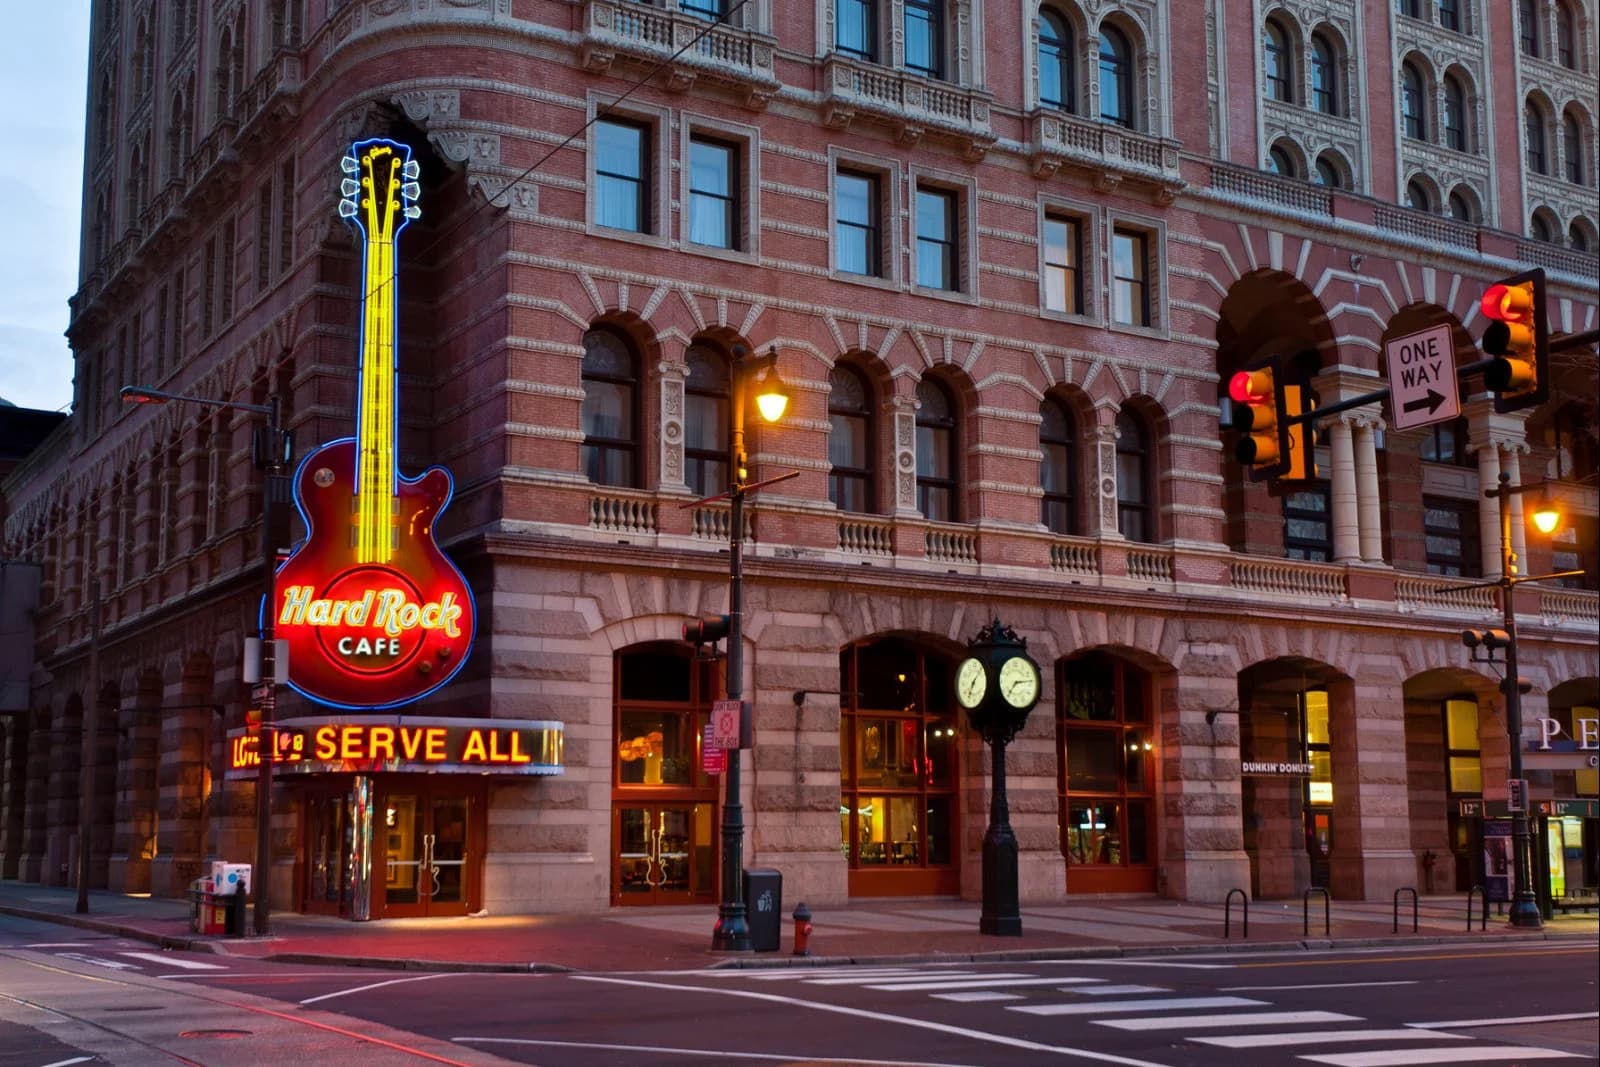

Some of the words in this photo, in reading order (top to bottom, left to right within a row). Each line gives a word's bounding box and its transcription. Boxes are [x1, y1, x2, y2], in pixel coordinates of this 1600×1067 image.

[1400, 337, 1440, 365] ONE
[1401, 360, 1442, 389] WAY
[279, 586, 376, 627] Hard
[373, 588, 462, 639] Rock
[337, 636, 400, 656] CAFE
[315, 726, 448, 760] SERVE
[462, 729, 531, 763] ALL
